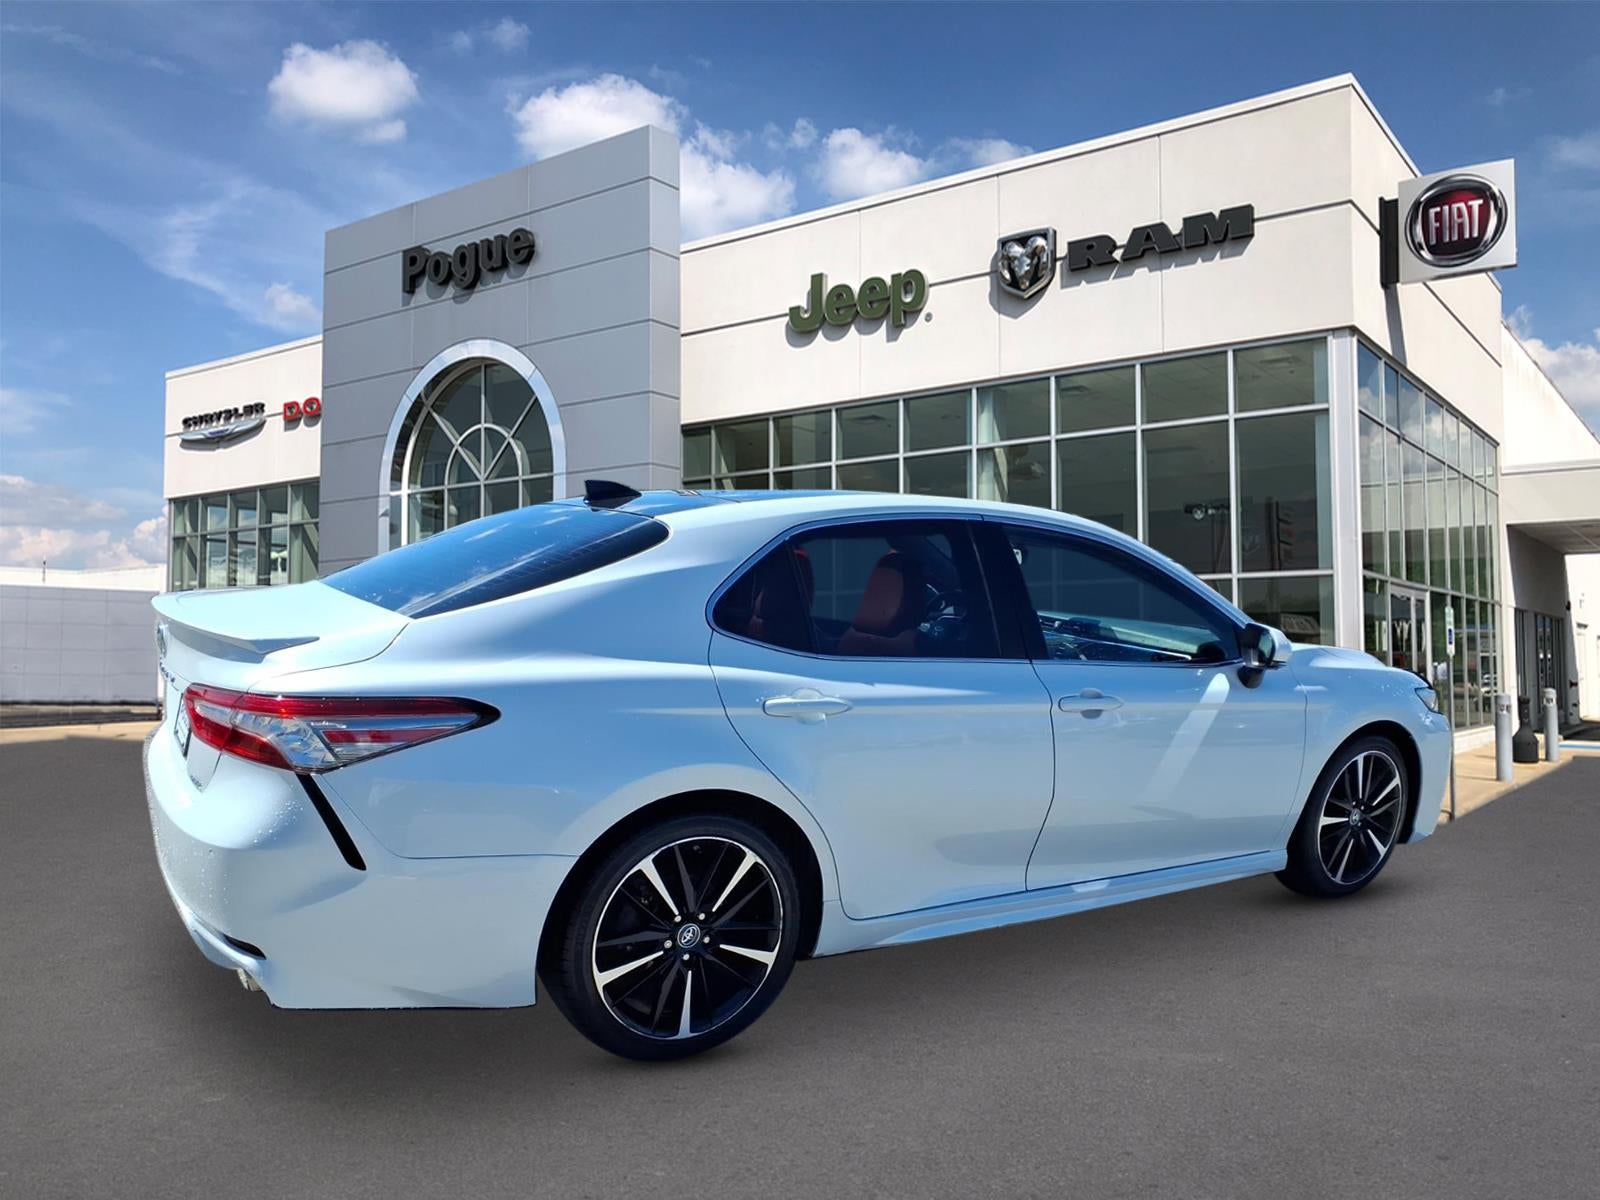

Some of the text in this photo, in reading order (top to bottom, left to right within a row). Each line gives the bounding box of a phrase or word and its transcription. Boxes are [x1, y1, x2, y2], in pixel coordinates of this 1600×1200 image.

[1067, 203, 1254, 271] RAM
[1429, 199, 1483, 245] FIAT
[402, 228, 535, 294] Pogue
[789, 269, 928, 333] Jeep
